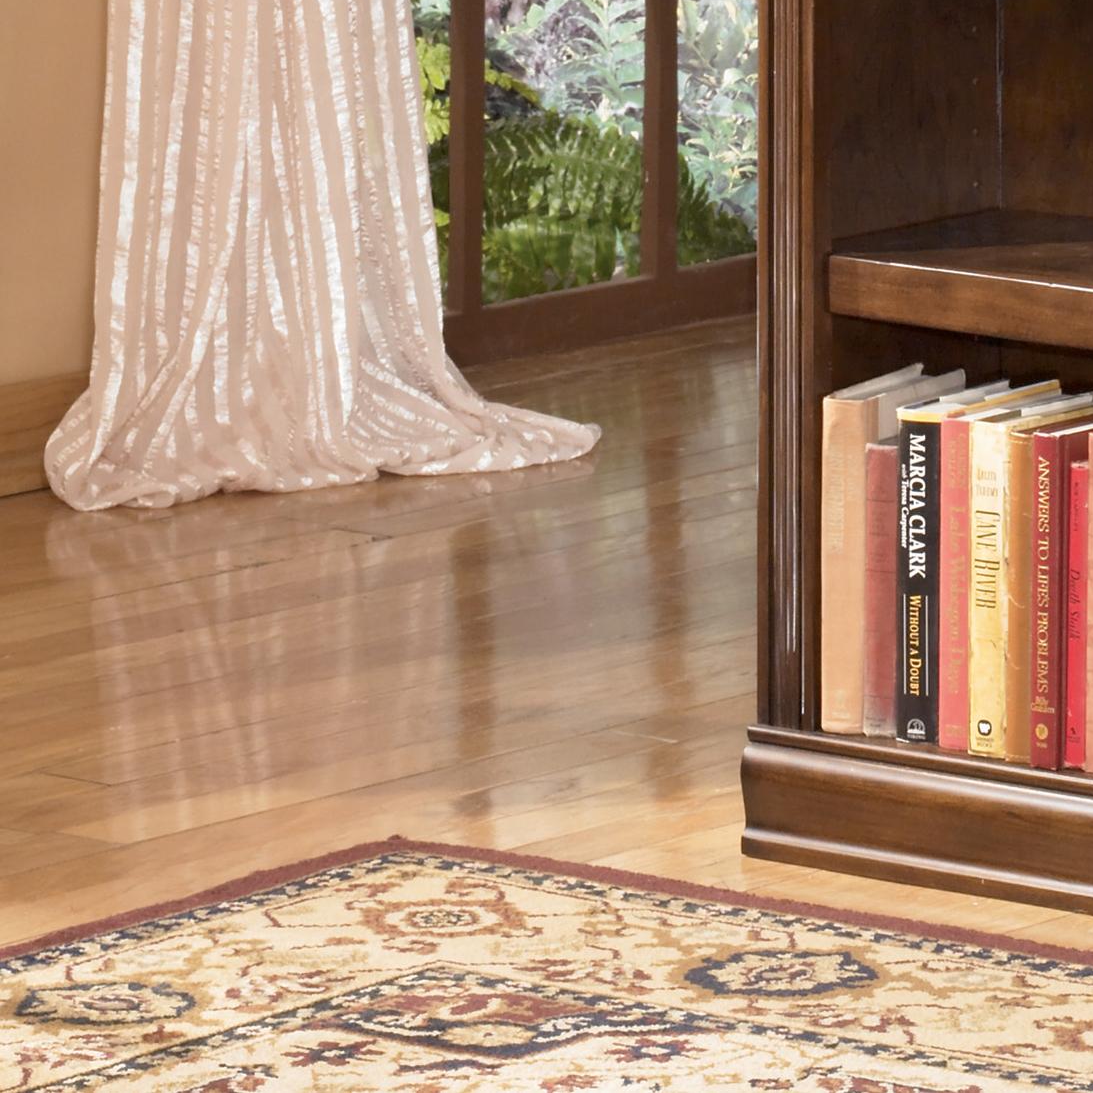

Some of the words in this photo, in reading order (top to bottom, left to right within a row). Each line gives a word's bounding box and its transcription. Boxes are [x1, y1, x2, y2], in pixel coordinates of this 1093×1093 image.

[901, 479, 910, 505] Teresa
[909, 434, 926, 510] MARCIA
[1038, 456, 1050, 533] ANSWERS
[900, 507, 910, 549] Carpenter
[909, 515, 926, 578] CLARK
[975, 510, 1000, 552] CANE
[1038, 537, 1050, 561] TO
[975, 558, 1000, 609] RIVER
[1037, 612, 1049, 693] PROBLEMS
